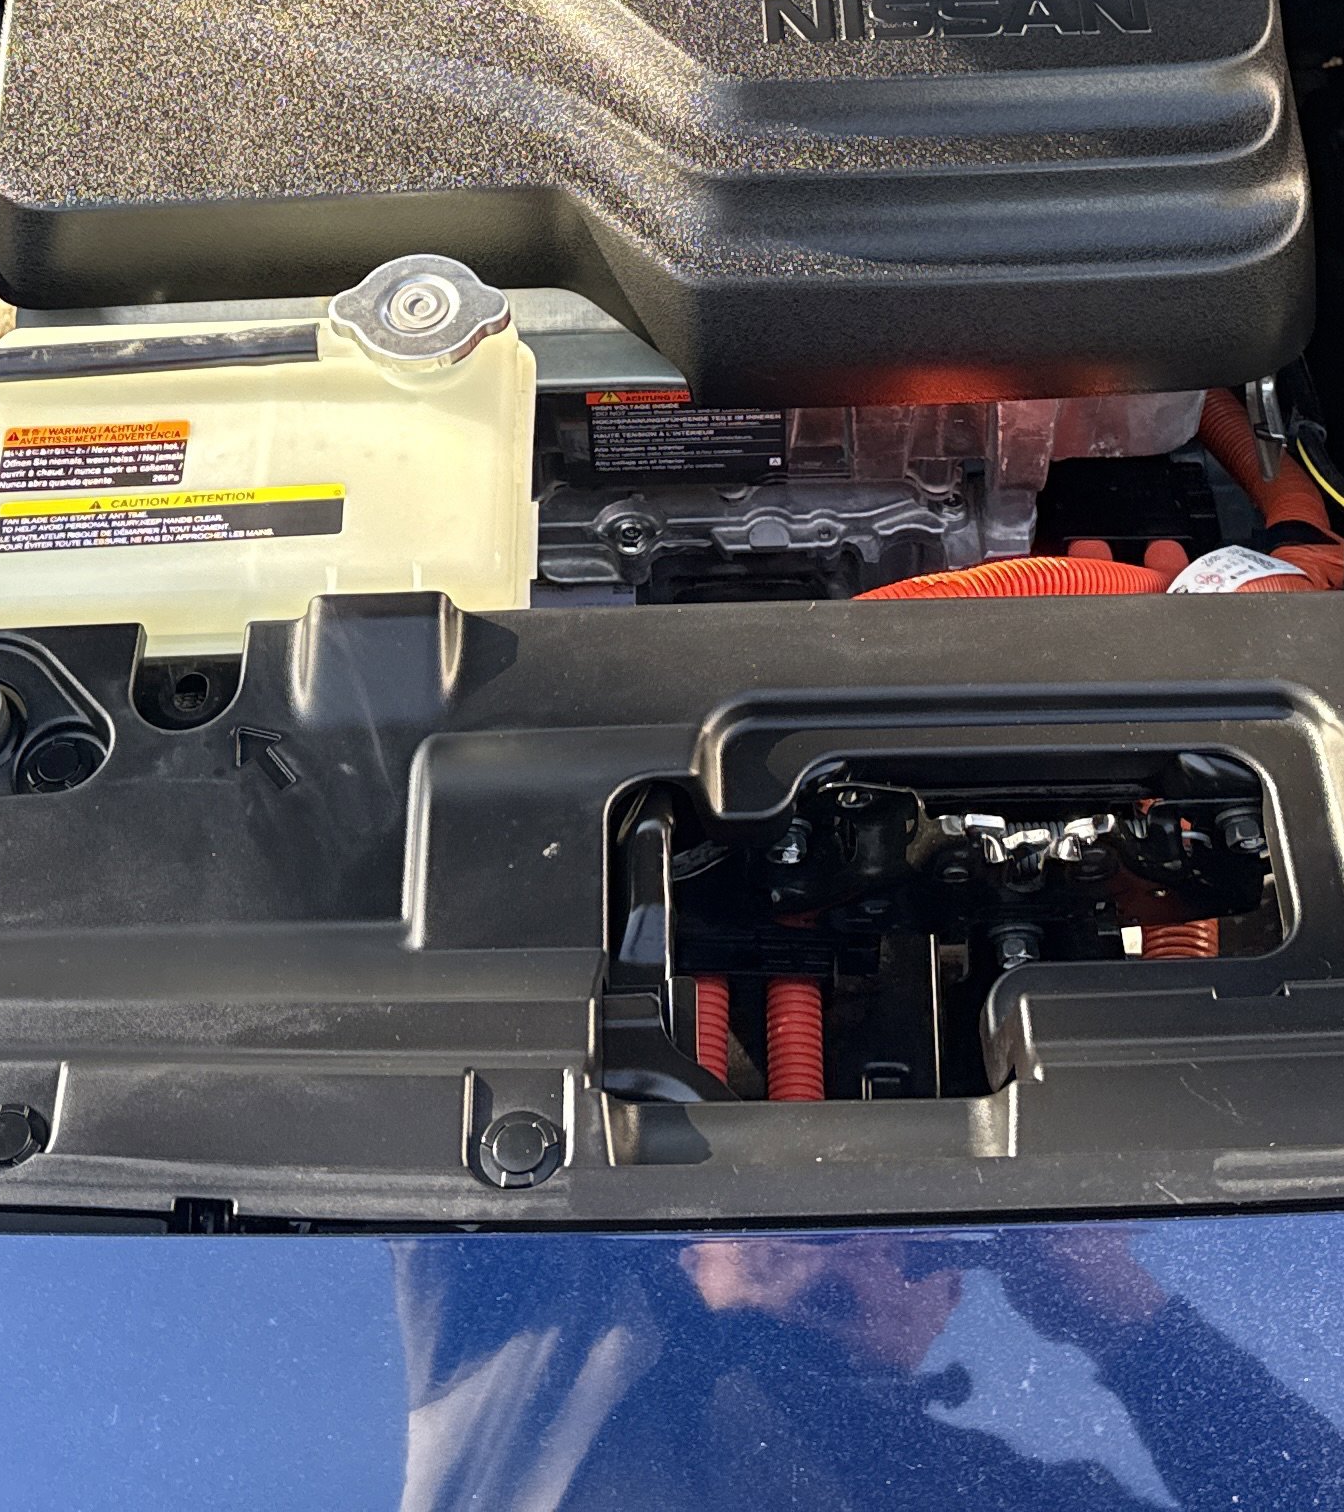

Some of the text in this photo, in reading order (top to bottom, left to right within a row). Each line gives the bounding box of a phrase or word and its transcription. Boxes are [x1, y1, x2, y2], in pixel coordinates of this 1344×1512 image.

[48, 426, 97, 436] WARNING
[103, 423, 153, 434] ACHTUNG
[18, 433, 104, 446] AVERTISSEMENT
[110, 496, 169, 509] CAUTION
[183, 491, 255, 504] ATTENTION
[1, 526, 15, 534] TO
[14, 525, 37, 533] HELP
[37, 523, 65, 532] AVOID
[64, 520, 110, 530] PERSONAL
[163, 515, 193, 524] HANDS
[2, 518, 20, 526] FAN
[20, 516, 49, 525] BLADE
[49, 515, 69, 523] CAN
[69, 513, 96, 522] START
[108, 511, 128, 520] ANY
[0, 535, 11, 543] LE
[11, 532, 66, 542] VENTILATEUR
[67, 530, 99, 539] RISQUE
[100, 529, 113, 537] DE
[169, 524, 191, 533] TOUT
[54, 539, 82, 548] TOUTE
[130, 535, 143, 544] NE
[143, 534, 161, 543] PAS
[161, 533, 175, 542] EN
[175, 530, 228, 541] APPROCHER
[228, 530, 245, 538] LES
